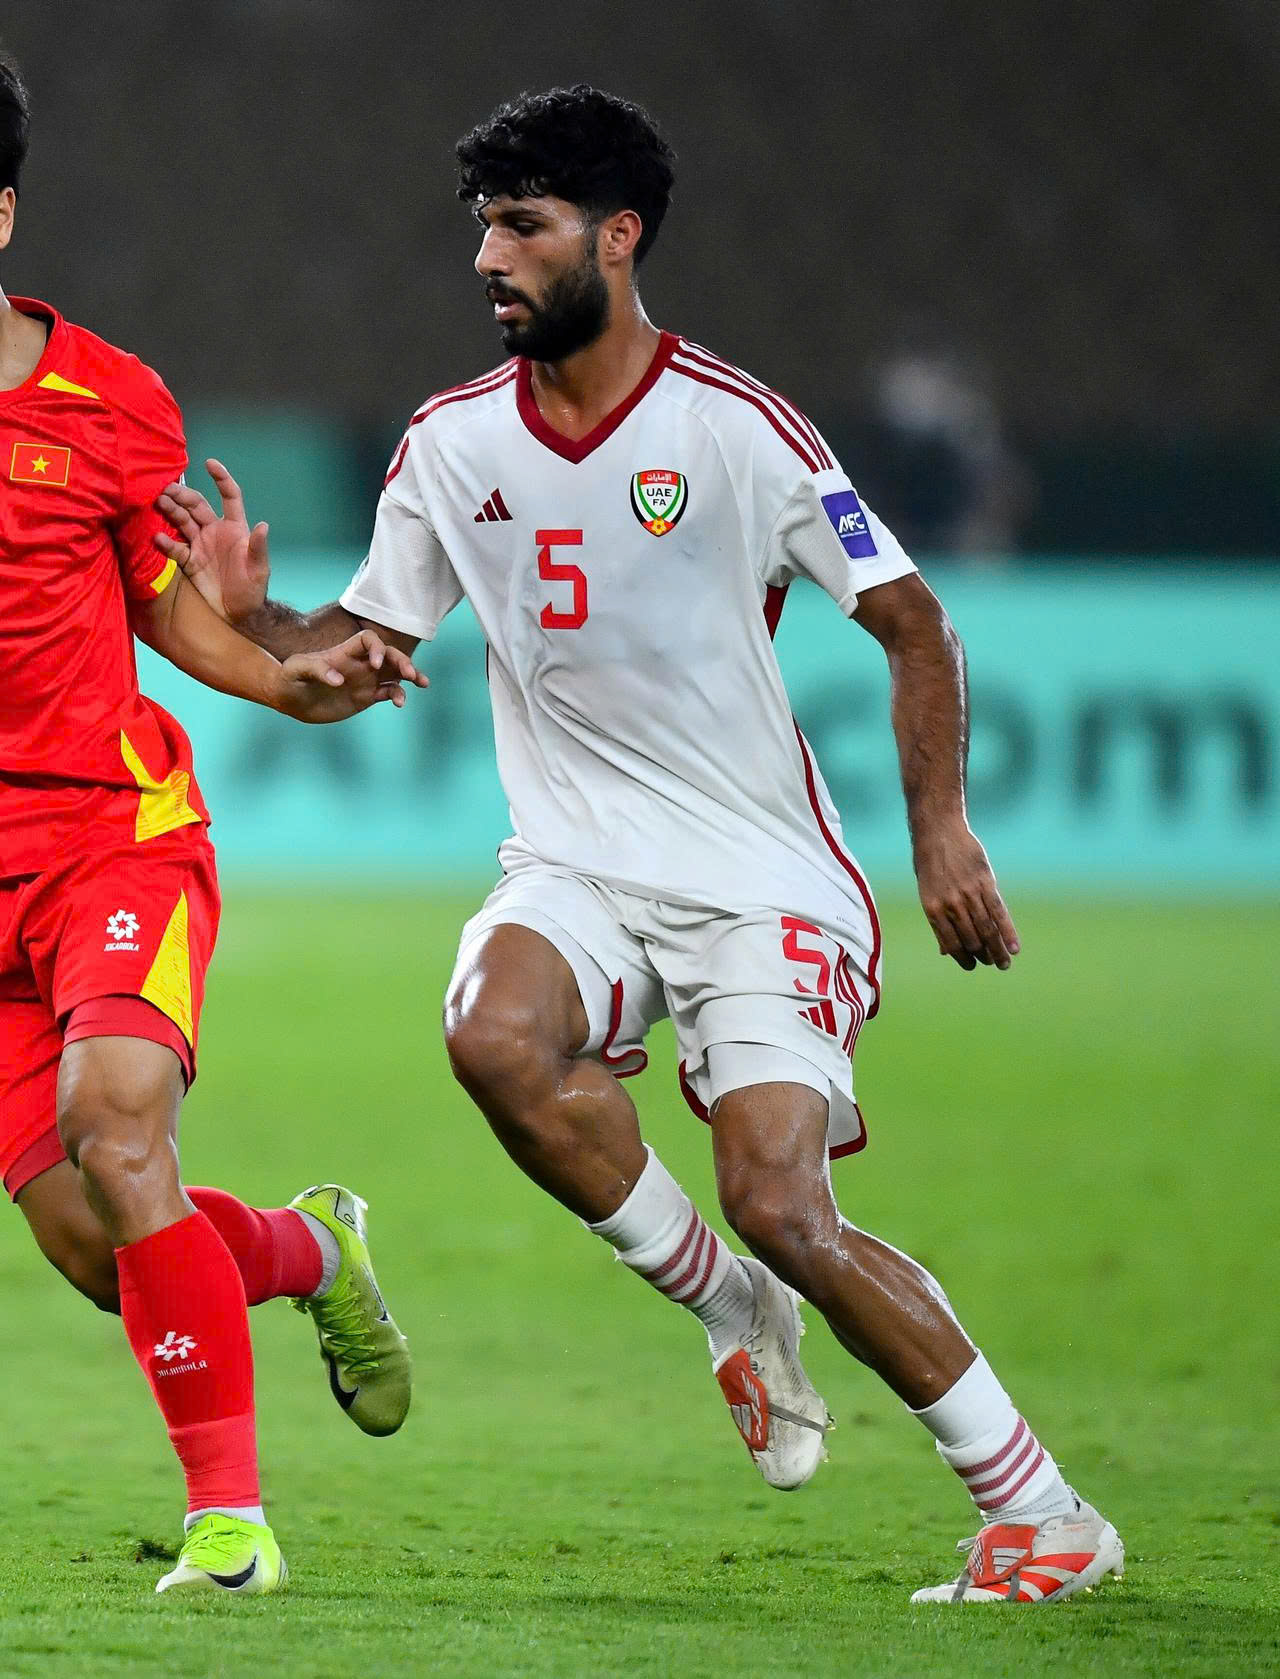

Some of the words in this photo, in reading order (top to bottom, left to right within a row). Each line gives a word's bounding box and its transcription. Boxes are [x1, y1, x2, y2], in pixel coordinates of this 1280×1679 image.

[646, 488, 672, 497] UAE
[838, 512, 865, 534] AFC
[535, 529, 589, 630] 5
